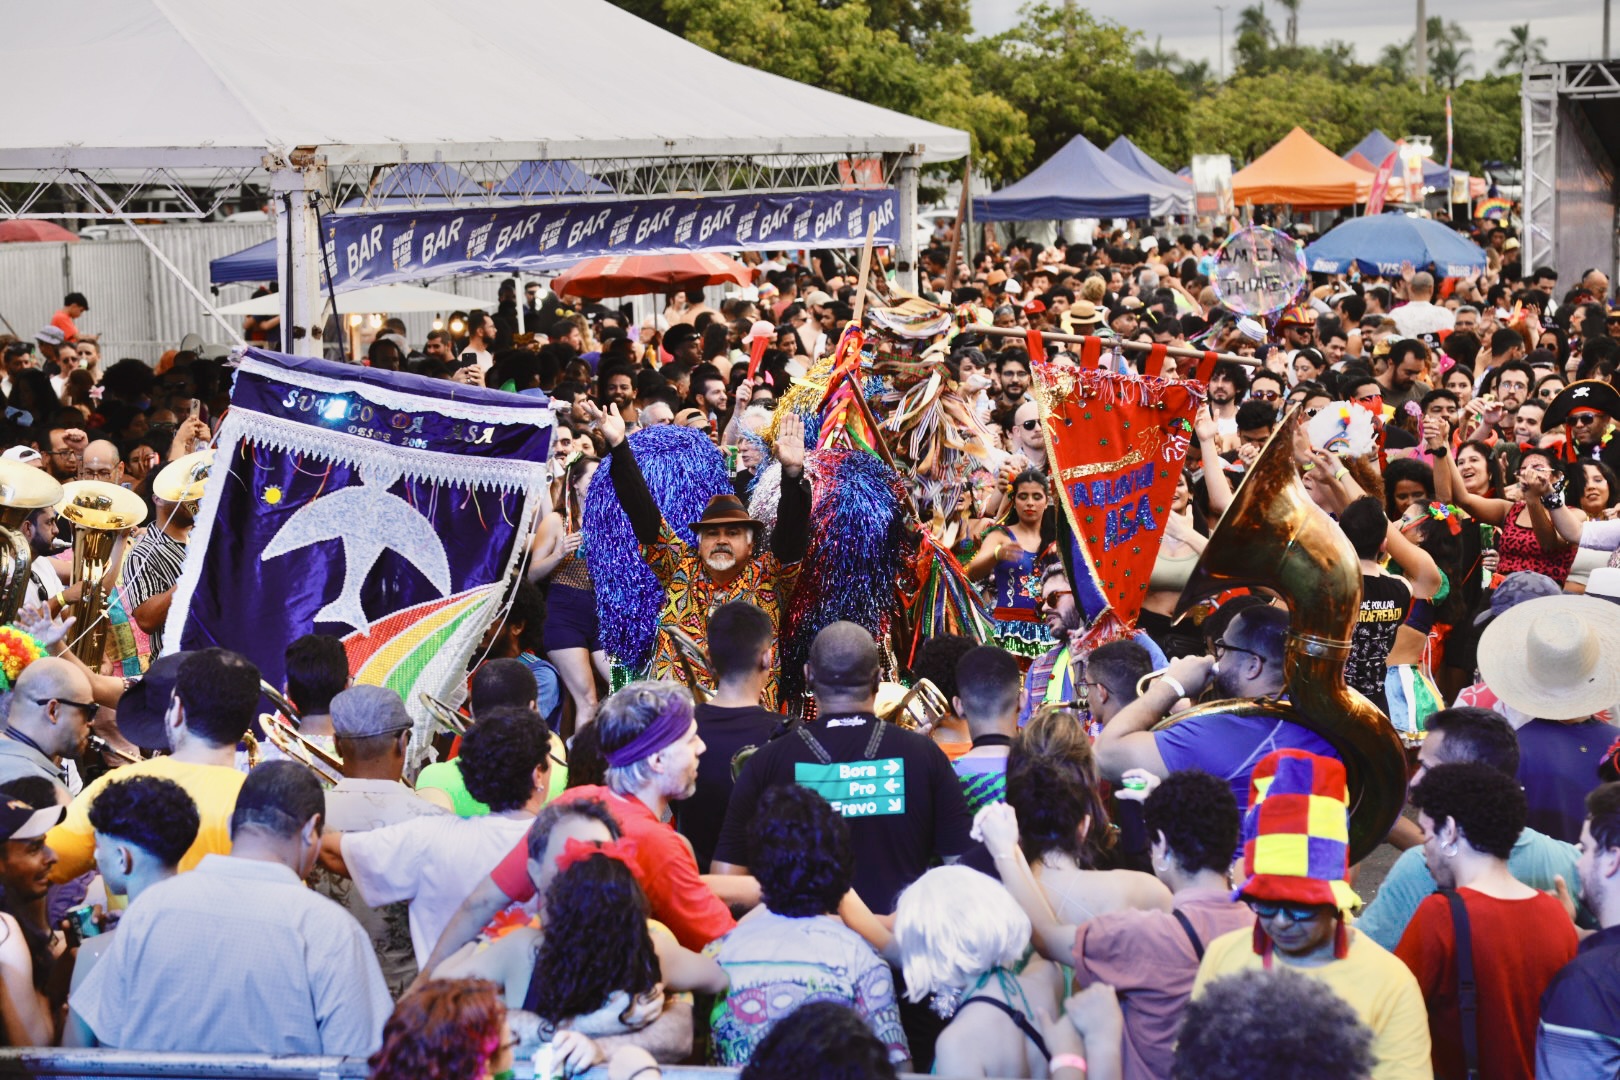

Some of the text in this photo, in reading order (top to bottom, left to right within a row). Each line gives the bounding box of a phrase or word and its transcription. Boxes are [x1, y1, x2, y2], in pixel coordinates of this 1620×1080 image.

[495, 212, 541, 254] BAR
[567, 208, 611, 248] BAR
[635, 205, 675, 244] BAR
[699, 203, 736, 242] BAR
[759, 202, 793, 240] BAR
[815, 200, 843, 238] BAR
[347, 224, 383, 276] BAR
[422, 216, 464, 265] BAR
[1219, 247, 1281, 263] AMGA
[1377, 262, 1403, 275] VIS
[402, 437, 428, 449] 2006
[1104, 494, 1157, 551] ASA
[840, 765, 876, 778] Bora
[849, 782, 876, 796] Pro
[831, 801, 877, 816] Frevo
